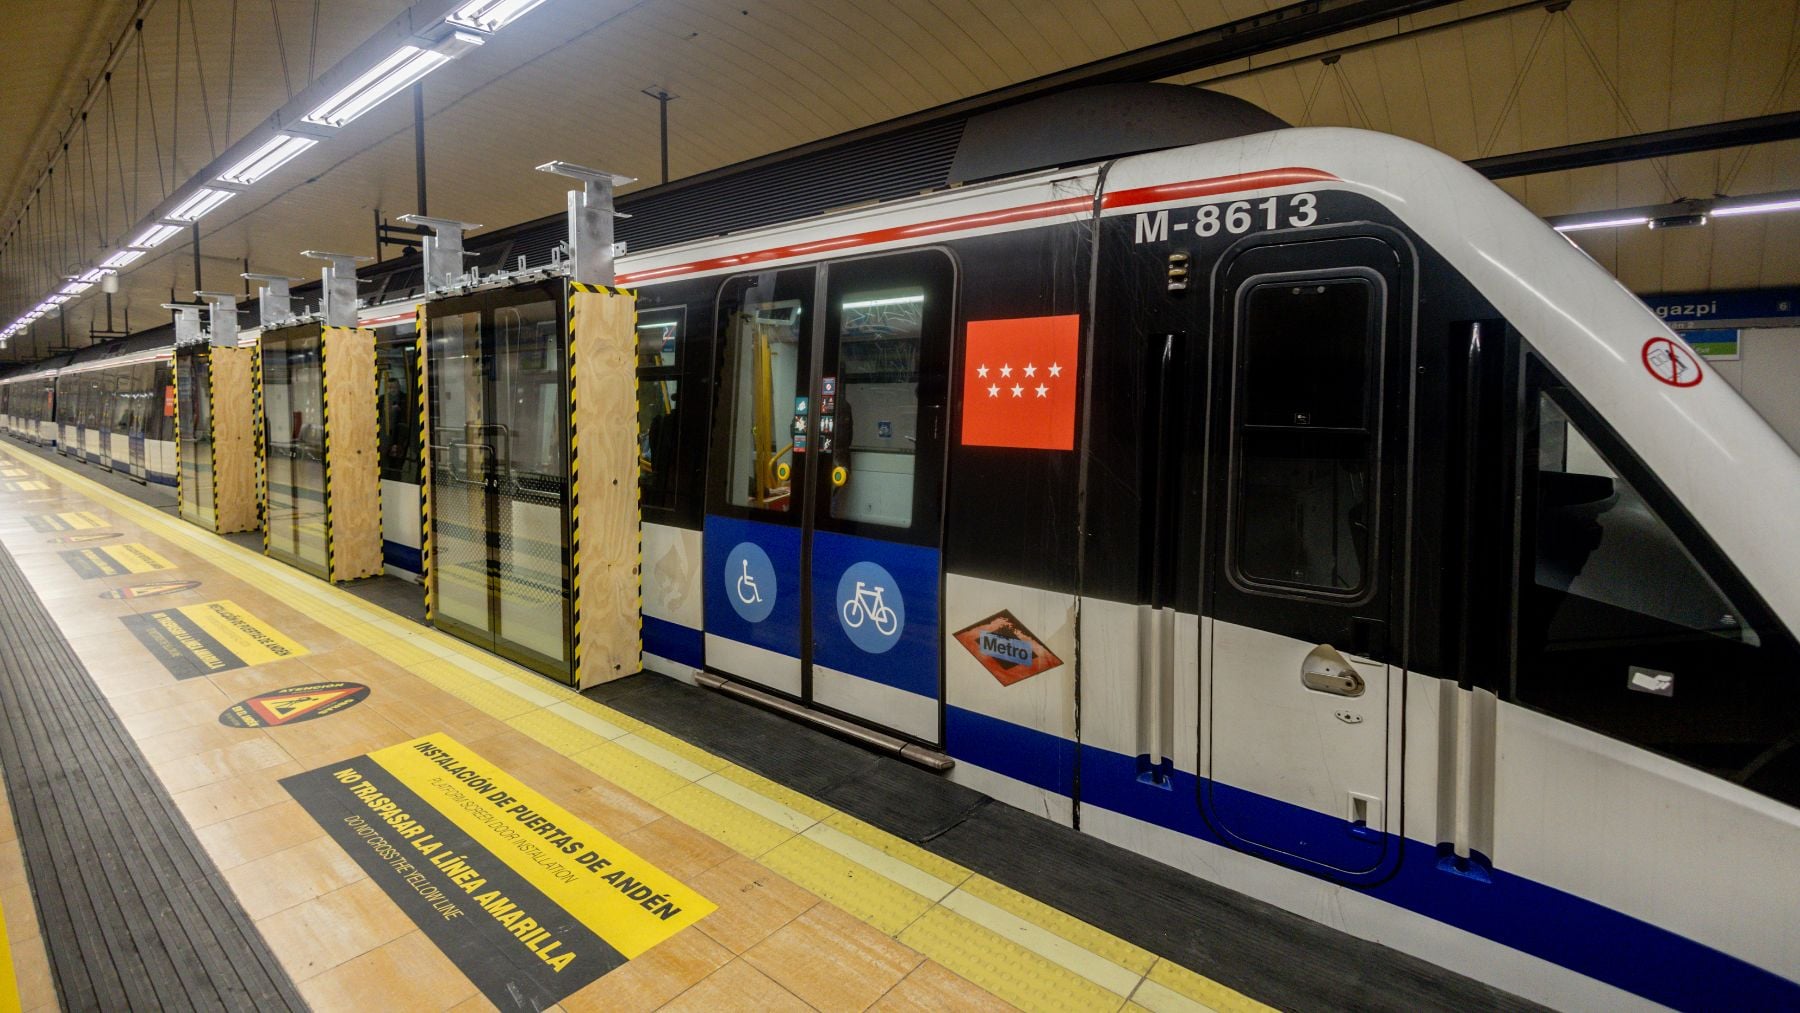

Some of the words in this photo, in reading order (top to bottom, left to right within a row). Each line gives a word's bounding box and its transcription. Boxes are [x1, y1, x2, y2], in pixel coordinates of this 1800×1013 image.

[1135, 193, 1317, 244] M-8613
[1652, 301, 1717, 318] gazpi
[983, 635, 1028, 660] Metro
[333, 768, 362, 784] NO
[342, 814, 365, 827] DO
[346, 780, 426, 838] TRASPASAR
[352, 823, 379, 840] NOT
[414, 741, 497, 794] INSTALACIÓN
[485, 791, 516, 807] DE
[505, 805, 585, 855] PUERTAS
[573, 851, 612, 873] DE
[599, 868, 683, 921] ANDÉN
[427, 777, 470, 804] PLATFORM
[459, 801, 497, 824] SCREEN
[487, 820, 520, 841] DOOR
[511, 838, 579, 884] INSTALLATION
[365, 836, 400, 860] CROSS
[409, 834, 446, 855] LA
[387, 857, 415, 875] THE
[428, 850, 490, 893] LÍNEA
[401, 869, 446, 904] YELLOW
[431, 898, 464, 921] LINE
[472, 888, 578, 972] AMARILLA
